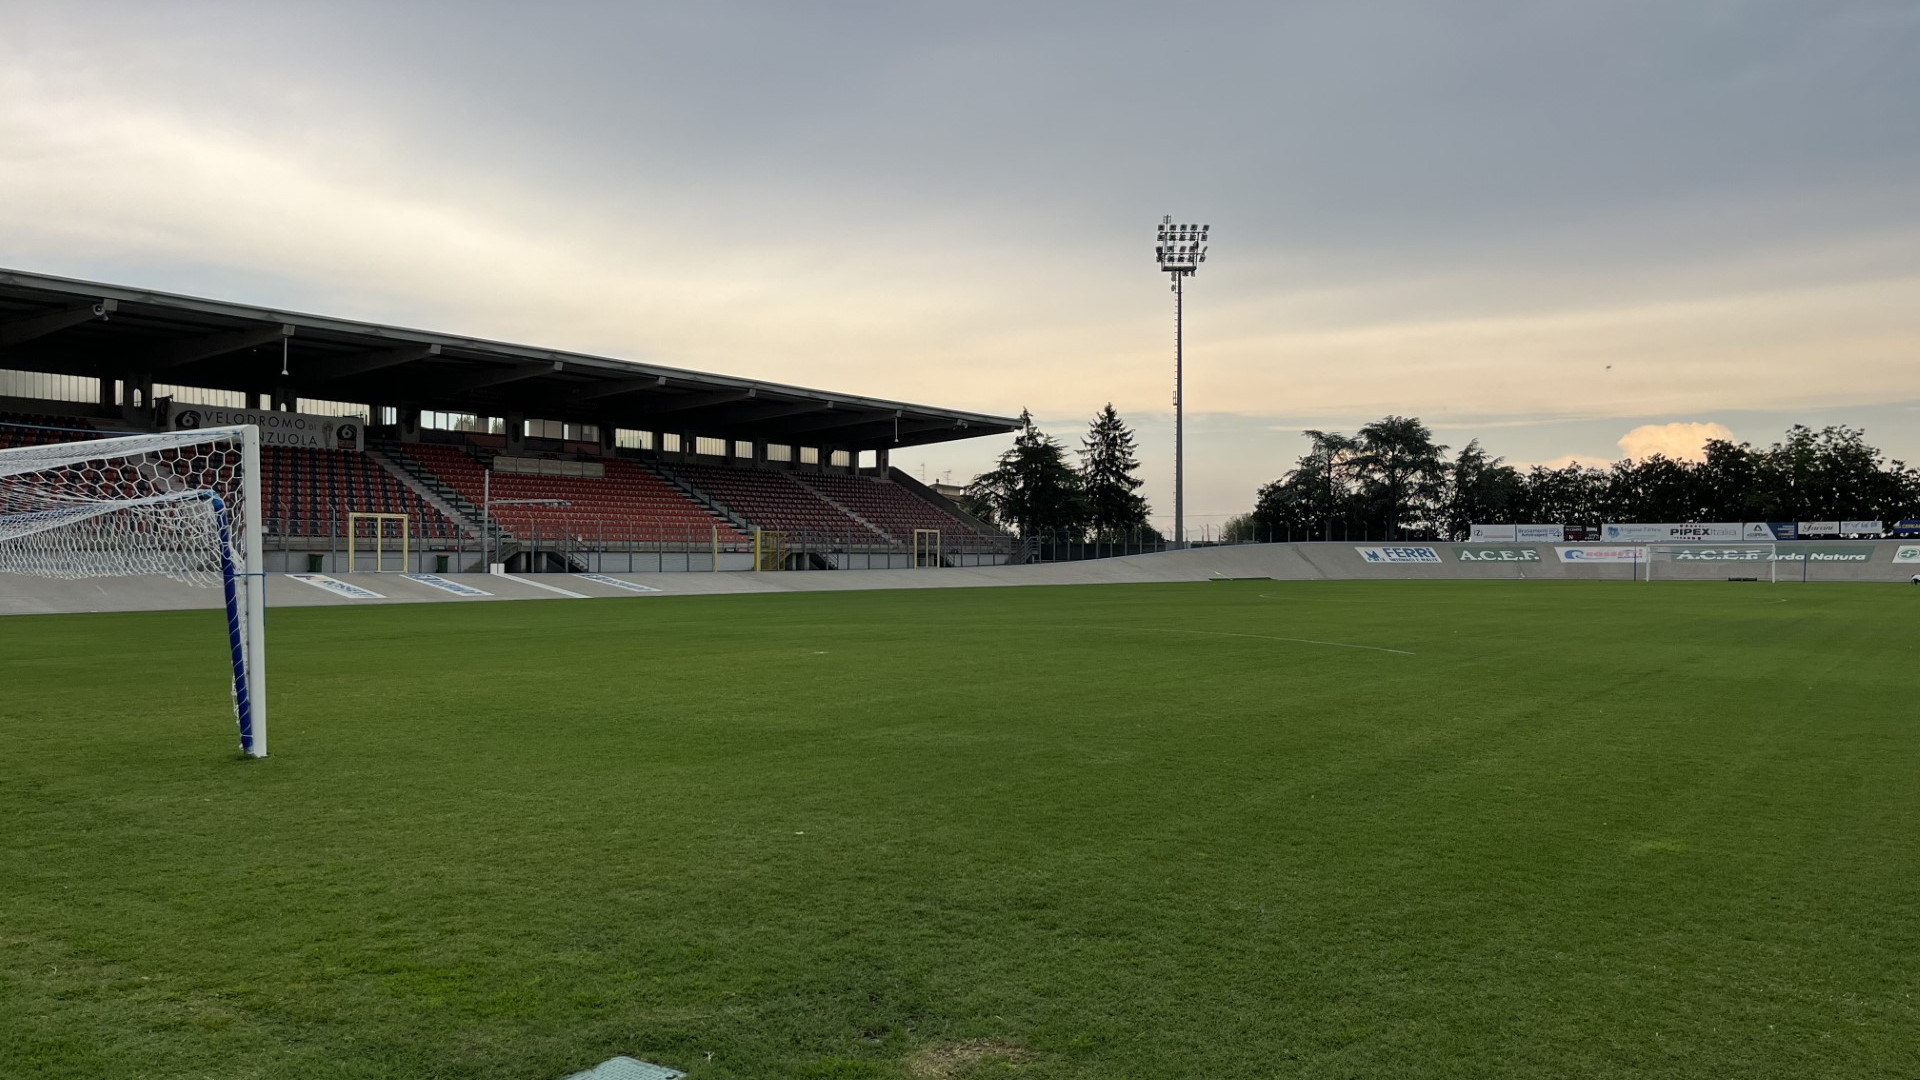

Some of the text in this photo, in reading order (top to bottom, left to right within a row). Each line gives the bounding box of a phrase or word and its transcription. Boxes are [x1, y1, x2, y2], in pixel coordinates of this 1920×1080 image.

[204, 411, 317, 431] VELODROMO DI
[1459, 550, 1540, 561] A.C.E.F.
[1766, 553, 1805, 561] Arda
[1809, 553, 1867, 561] Natura
